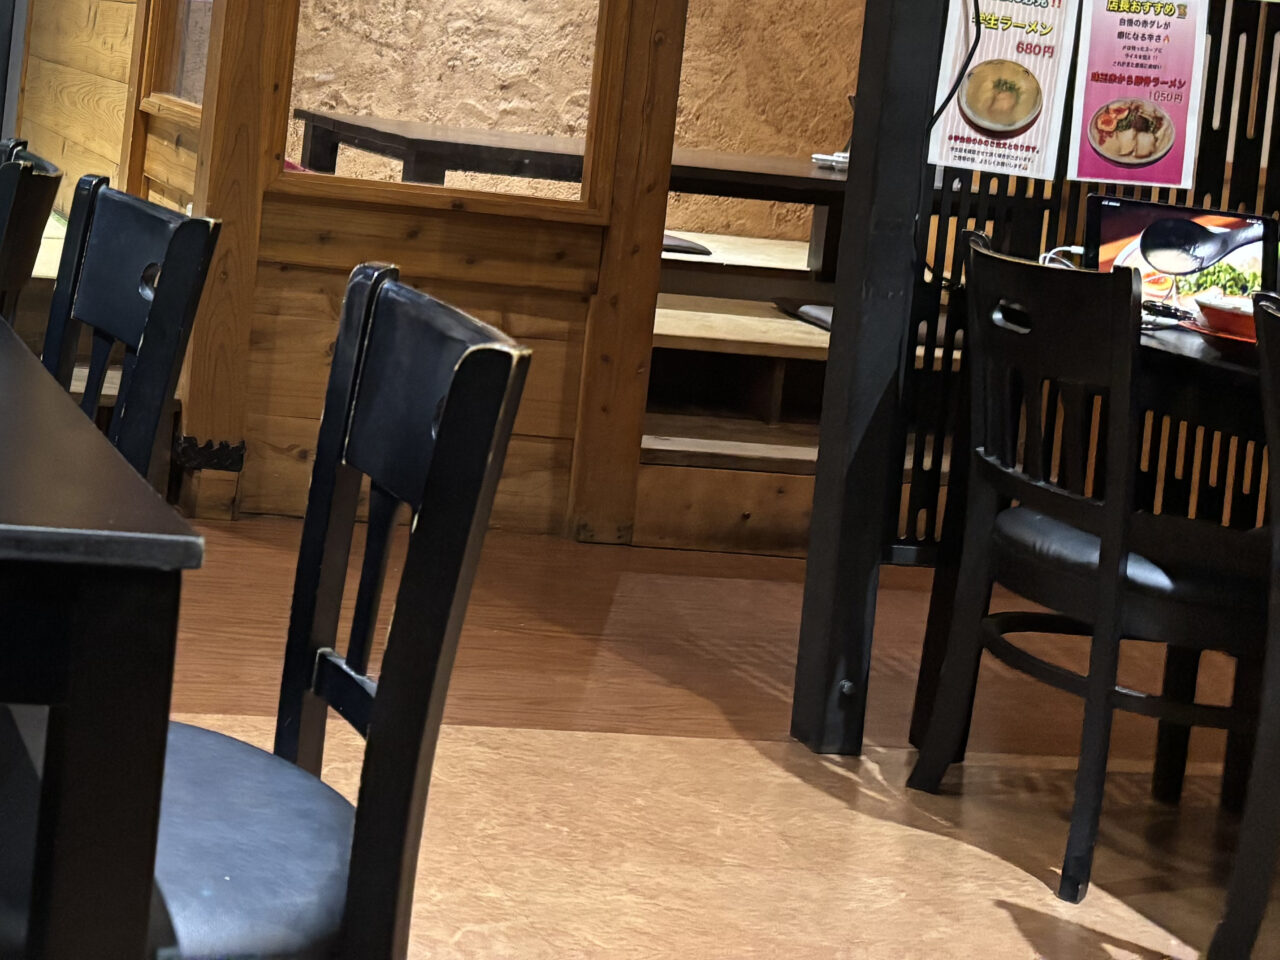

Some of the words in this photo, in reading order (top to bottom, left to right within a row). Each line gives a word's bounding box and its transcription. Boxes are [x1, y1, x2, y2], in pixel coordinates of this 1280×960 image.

[1119, 18, 1170, 30] 自慢の赤ダレが
[1016, 41, 1055, 58] 680円
[1149, 91, 1183, 104] 1050円
